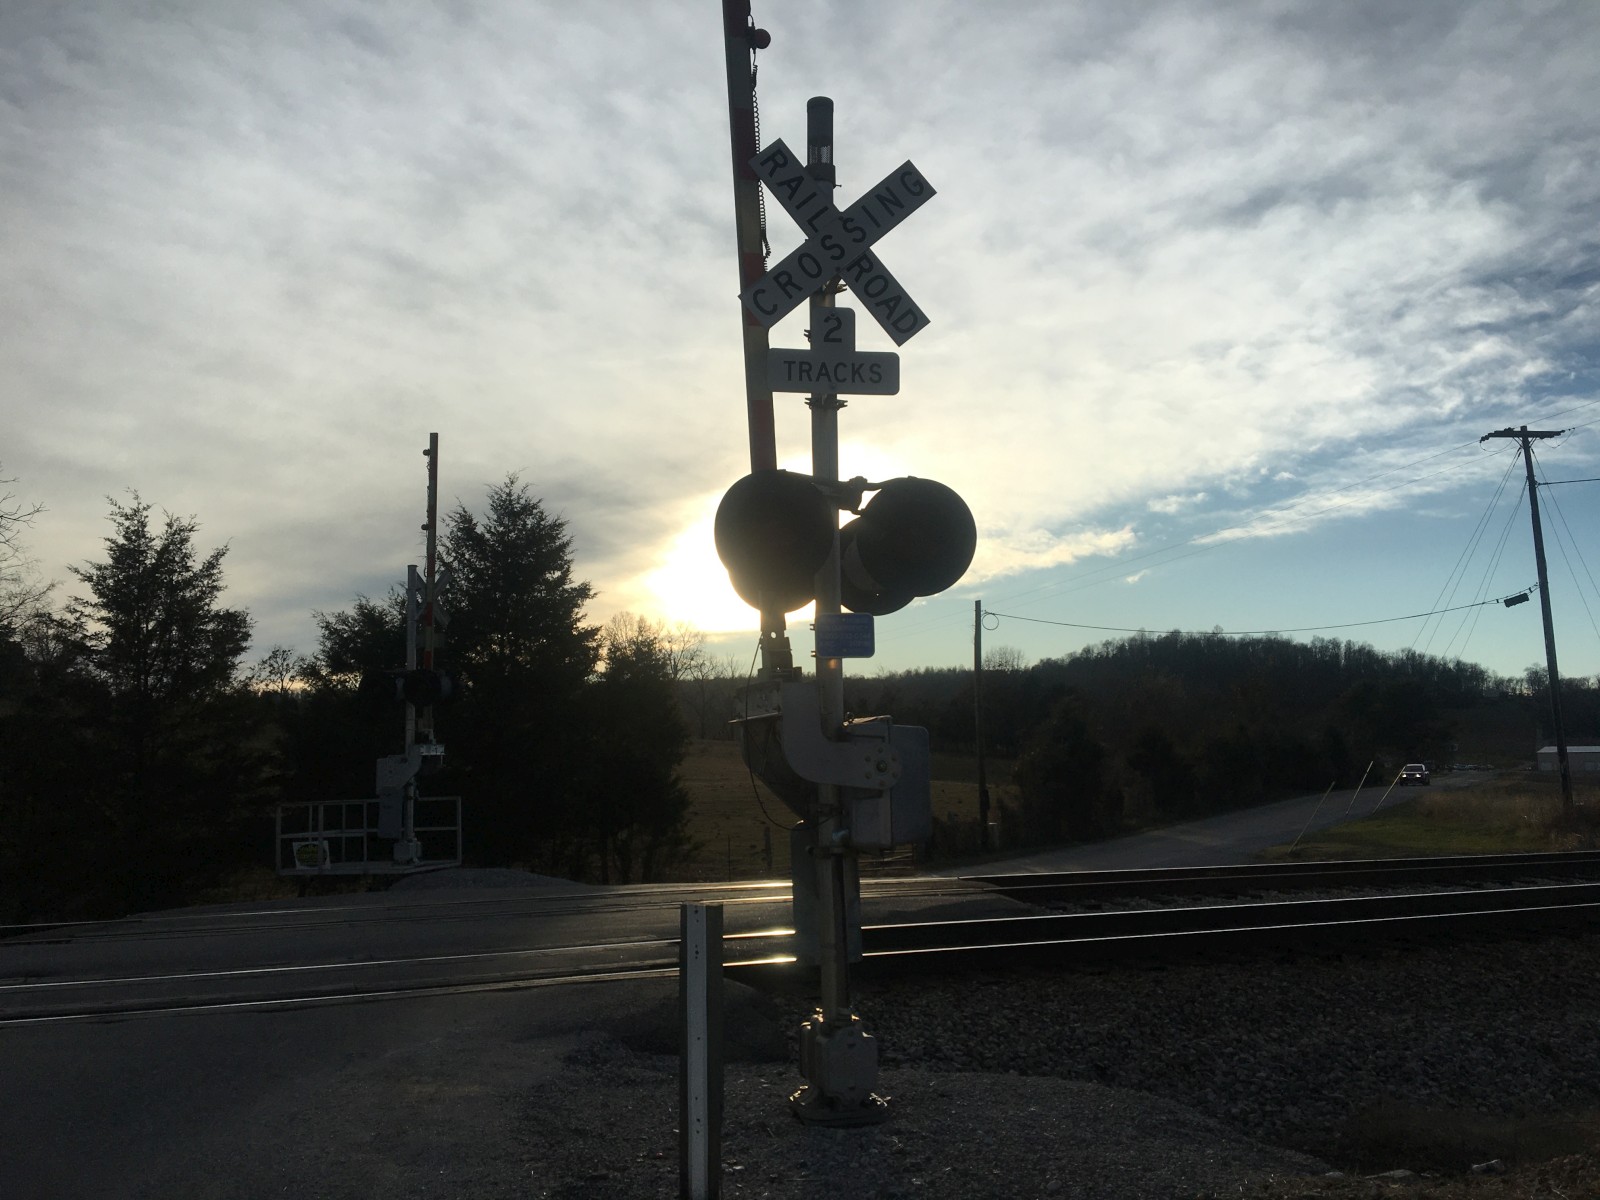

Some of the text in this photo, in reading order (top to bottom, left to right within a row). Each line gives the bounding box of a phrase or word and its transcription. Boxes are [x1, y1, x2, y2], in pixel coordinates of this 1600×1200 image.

[752, 170, 925, 316] CROSSING
[823, 315, 843, 343] 2
[783, 360, 883, 384] TRACKS
